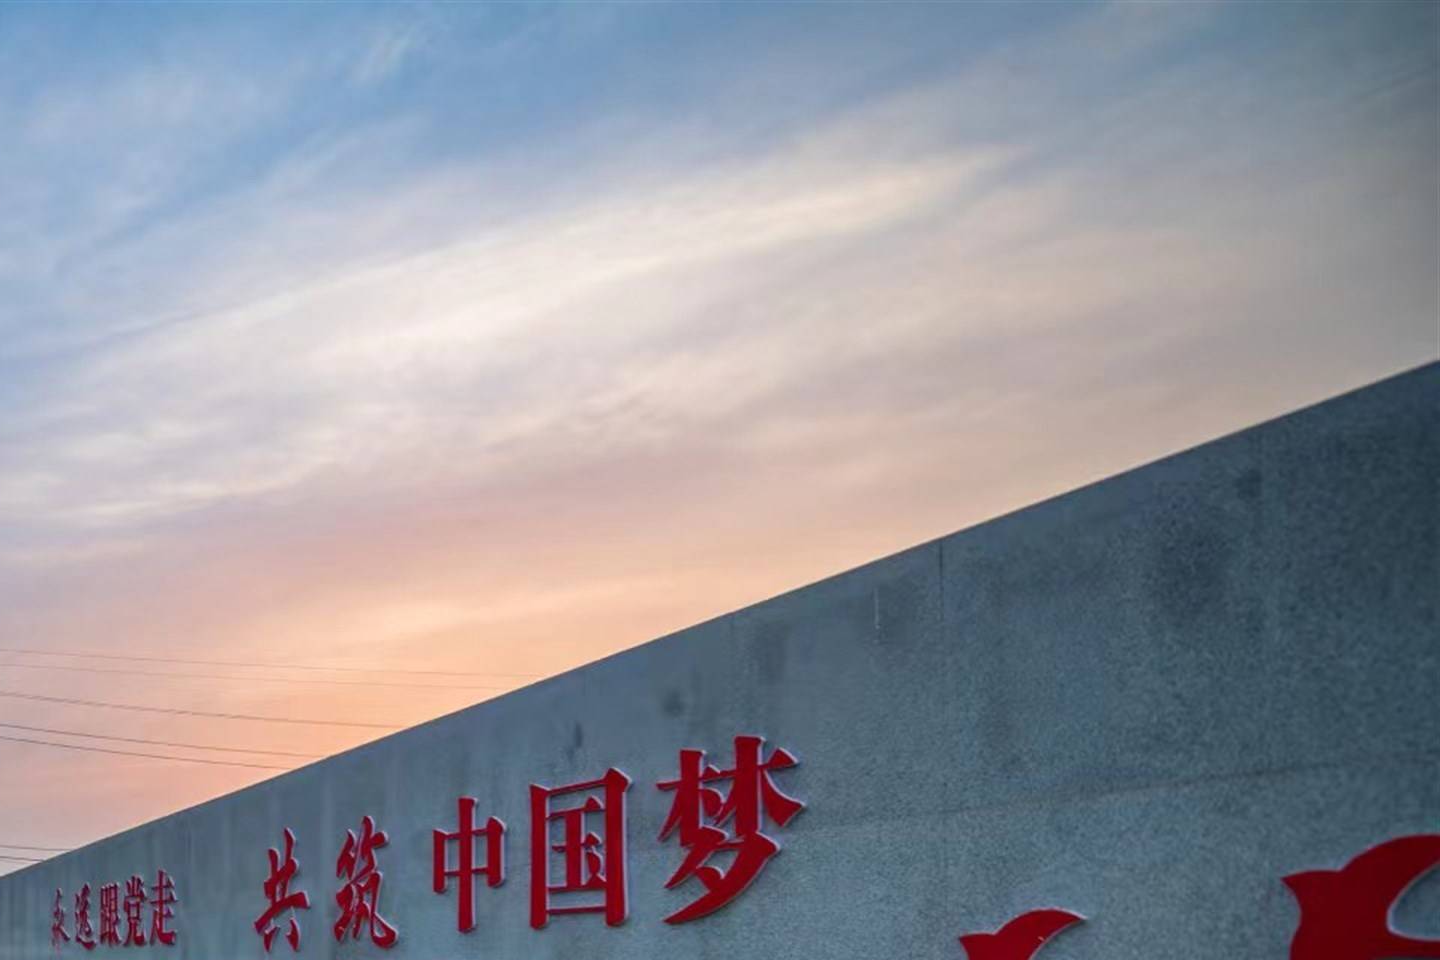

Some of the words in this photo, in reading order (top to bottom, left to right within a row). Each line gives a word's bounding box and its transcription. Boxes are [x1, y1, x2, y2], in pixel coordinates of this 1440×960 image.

[254, 735, 806, 952] 共筑中国梦
